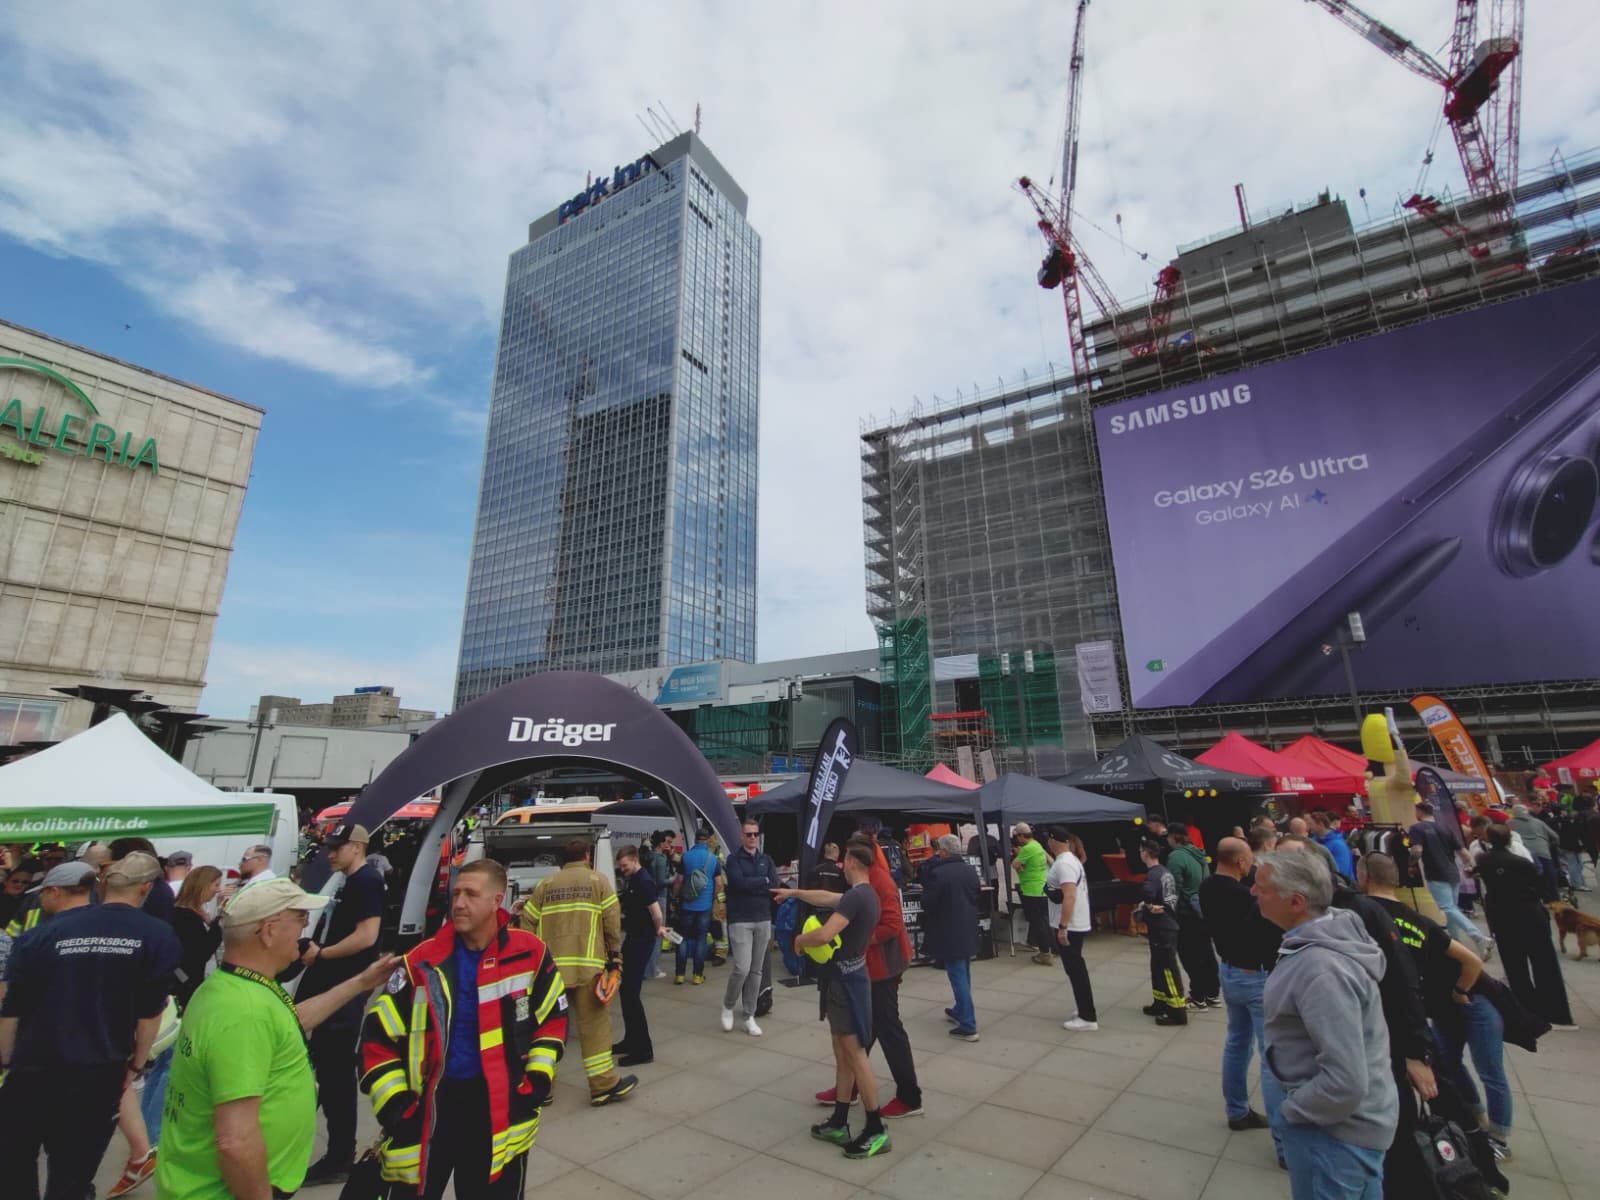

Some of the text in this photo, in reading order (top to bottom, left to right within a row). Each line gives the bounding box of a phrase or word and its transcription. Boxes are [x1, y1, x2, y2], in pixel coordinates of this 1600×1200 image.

[614, 154, 656, 188] inn
[1110, 384, 1252, 435] SAMSUNG
[0, 398, 159, 475] ALERIA
[1153, 452, 1369, 508] Galaxy S26 Ultra
[1195, 493, 1301, 526] Galaxy AI
[508, 716, 617, 747] Dräger
[0, 816, 149, 832] w.kolibrihilft.de
[903, 913, 917, 923] REW
[59, 946, 90, 956] BRAND
